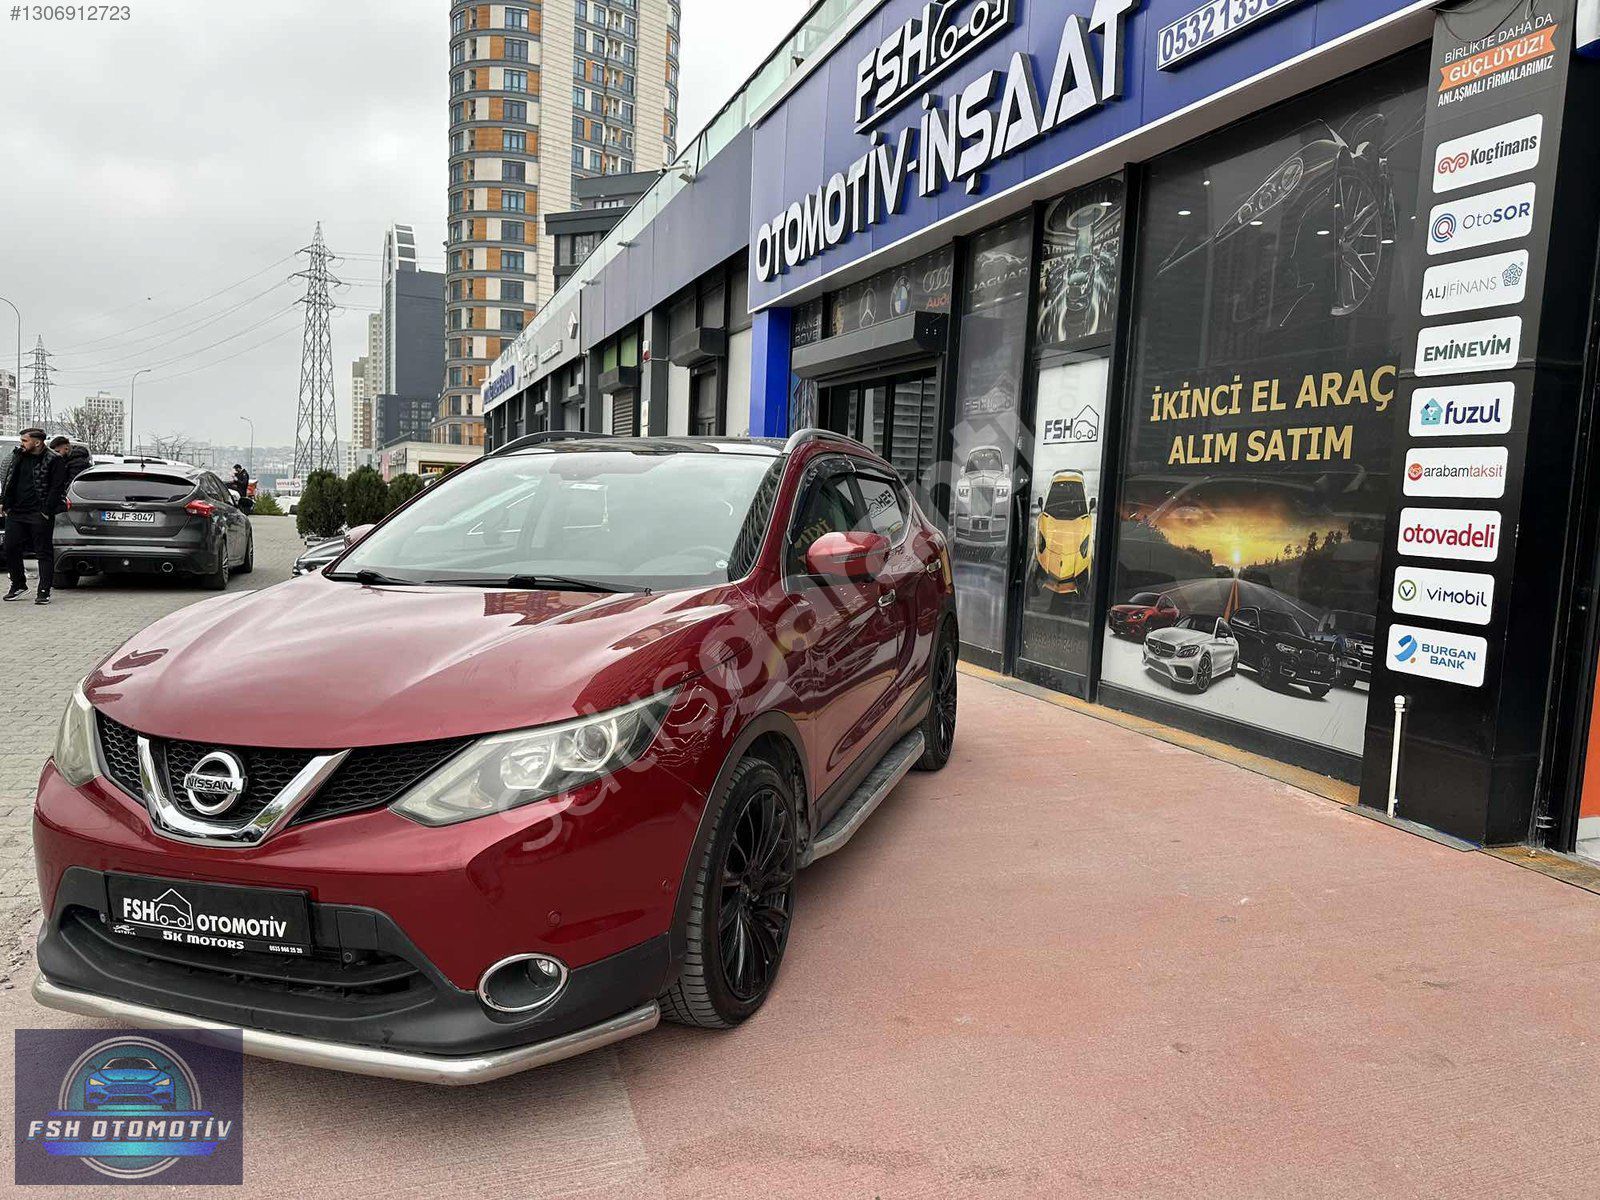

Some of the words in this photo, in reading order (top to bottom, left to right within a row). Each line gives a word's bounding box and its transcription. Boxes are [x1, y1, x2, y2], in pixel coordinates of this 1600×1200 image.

[1162, 7, 1215, 61] 0532
[1444, 35, 1496, 63] BİRLİKTE
[1498, 21, 1532, 42] DAHA
[1535, 13, 1553, 29] DA
[854, 2, 934, 123] FSH
[1449, 35, 1545, 81] GÜÇLÜYÜZ!
[1438, 83, 1485, 107] ANLAŞMALI
[1487, 55, 1554, 90] FİRMALARIMIZ
[1470, 135, 1537, 166] Koçfinans
[1463, 202, 1531, 229] OtoSOR
[1423, 334, 1511, 362] EMİNEVİM
[1150, 374, 1243, 422] İKİNCİ
[1250, 378, 1287, 413] EL
[1295, 364, 1396, 412] ARAÇ
[1445, 398, 1501, 425] fuzul
[1044, 418, 1073, 440] FSH
[1168, 431, 1238, 465] ALIM
[1245, 425, 1354, 462] SATIM
[1424, 463, 1503, 478] arabamtaksit
[106, 512, 116, 520] 34
[118, 512, 131, 520] JF
[132, 512, 153, 521] 3047
[1403, 523, 1496, 549] otovadeli
[1421, 643, 1477, 661] BURGAN
[1429, 656, 1465, 670] BANK
[187, 775, 233, 790] NISSAN
[123, 897, 156, 922] FSH
[196, 915, 287, 938] OTOMOTİV
[186, 932, 245, 950] MOTORS
